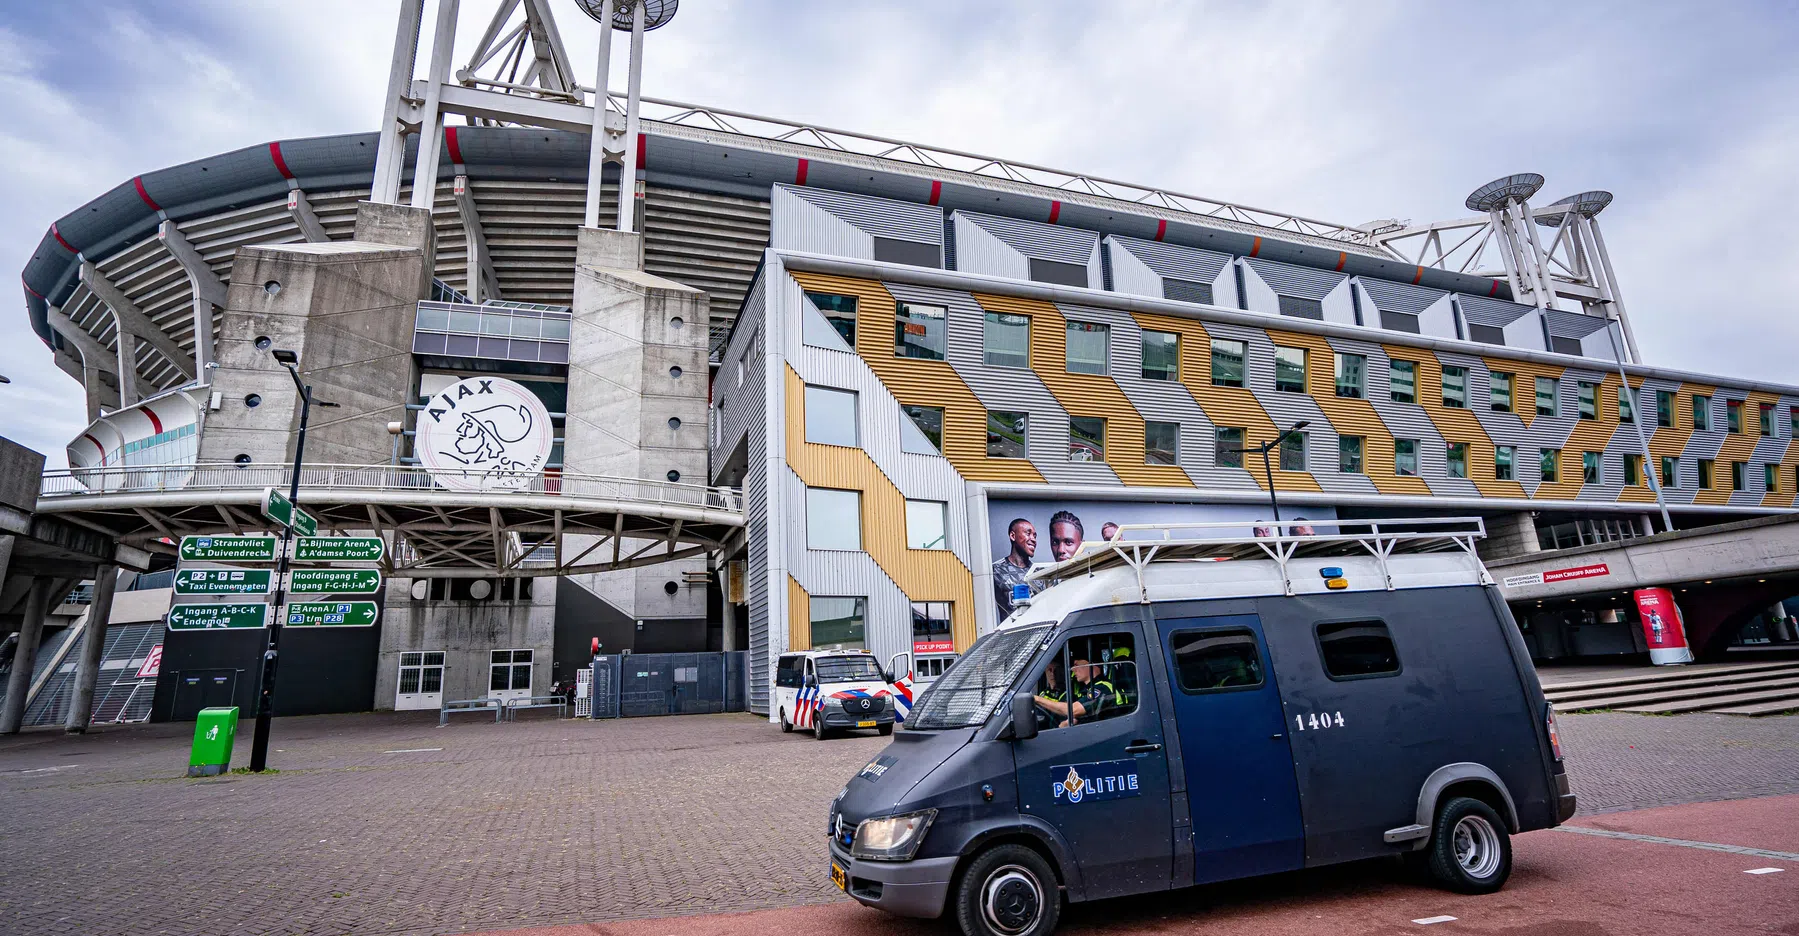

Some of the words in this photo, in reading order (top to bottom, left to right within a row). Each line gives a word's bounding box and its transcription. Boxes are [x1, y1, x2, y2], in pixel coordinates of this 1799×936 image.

[428, 380, 493, 423] AJAX
[213, 539, 265, 547] Strandvliet
[310, 540, 342, 549] Bijlmer
[207, 549, 271, 557] Duivendrecht
[294, 572, 351, 581] Hoofdingang
[292, 582, 323, 590] Ingang
[185, 607, 218, 617] Ingang
[220, 606, 257, 614] A-B-C-K
[1295, 711, 1345, 731] 1404
[1053, 774, 1139, 803] POLITIE
